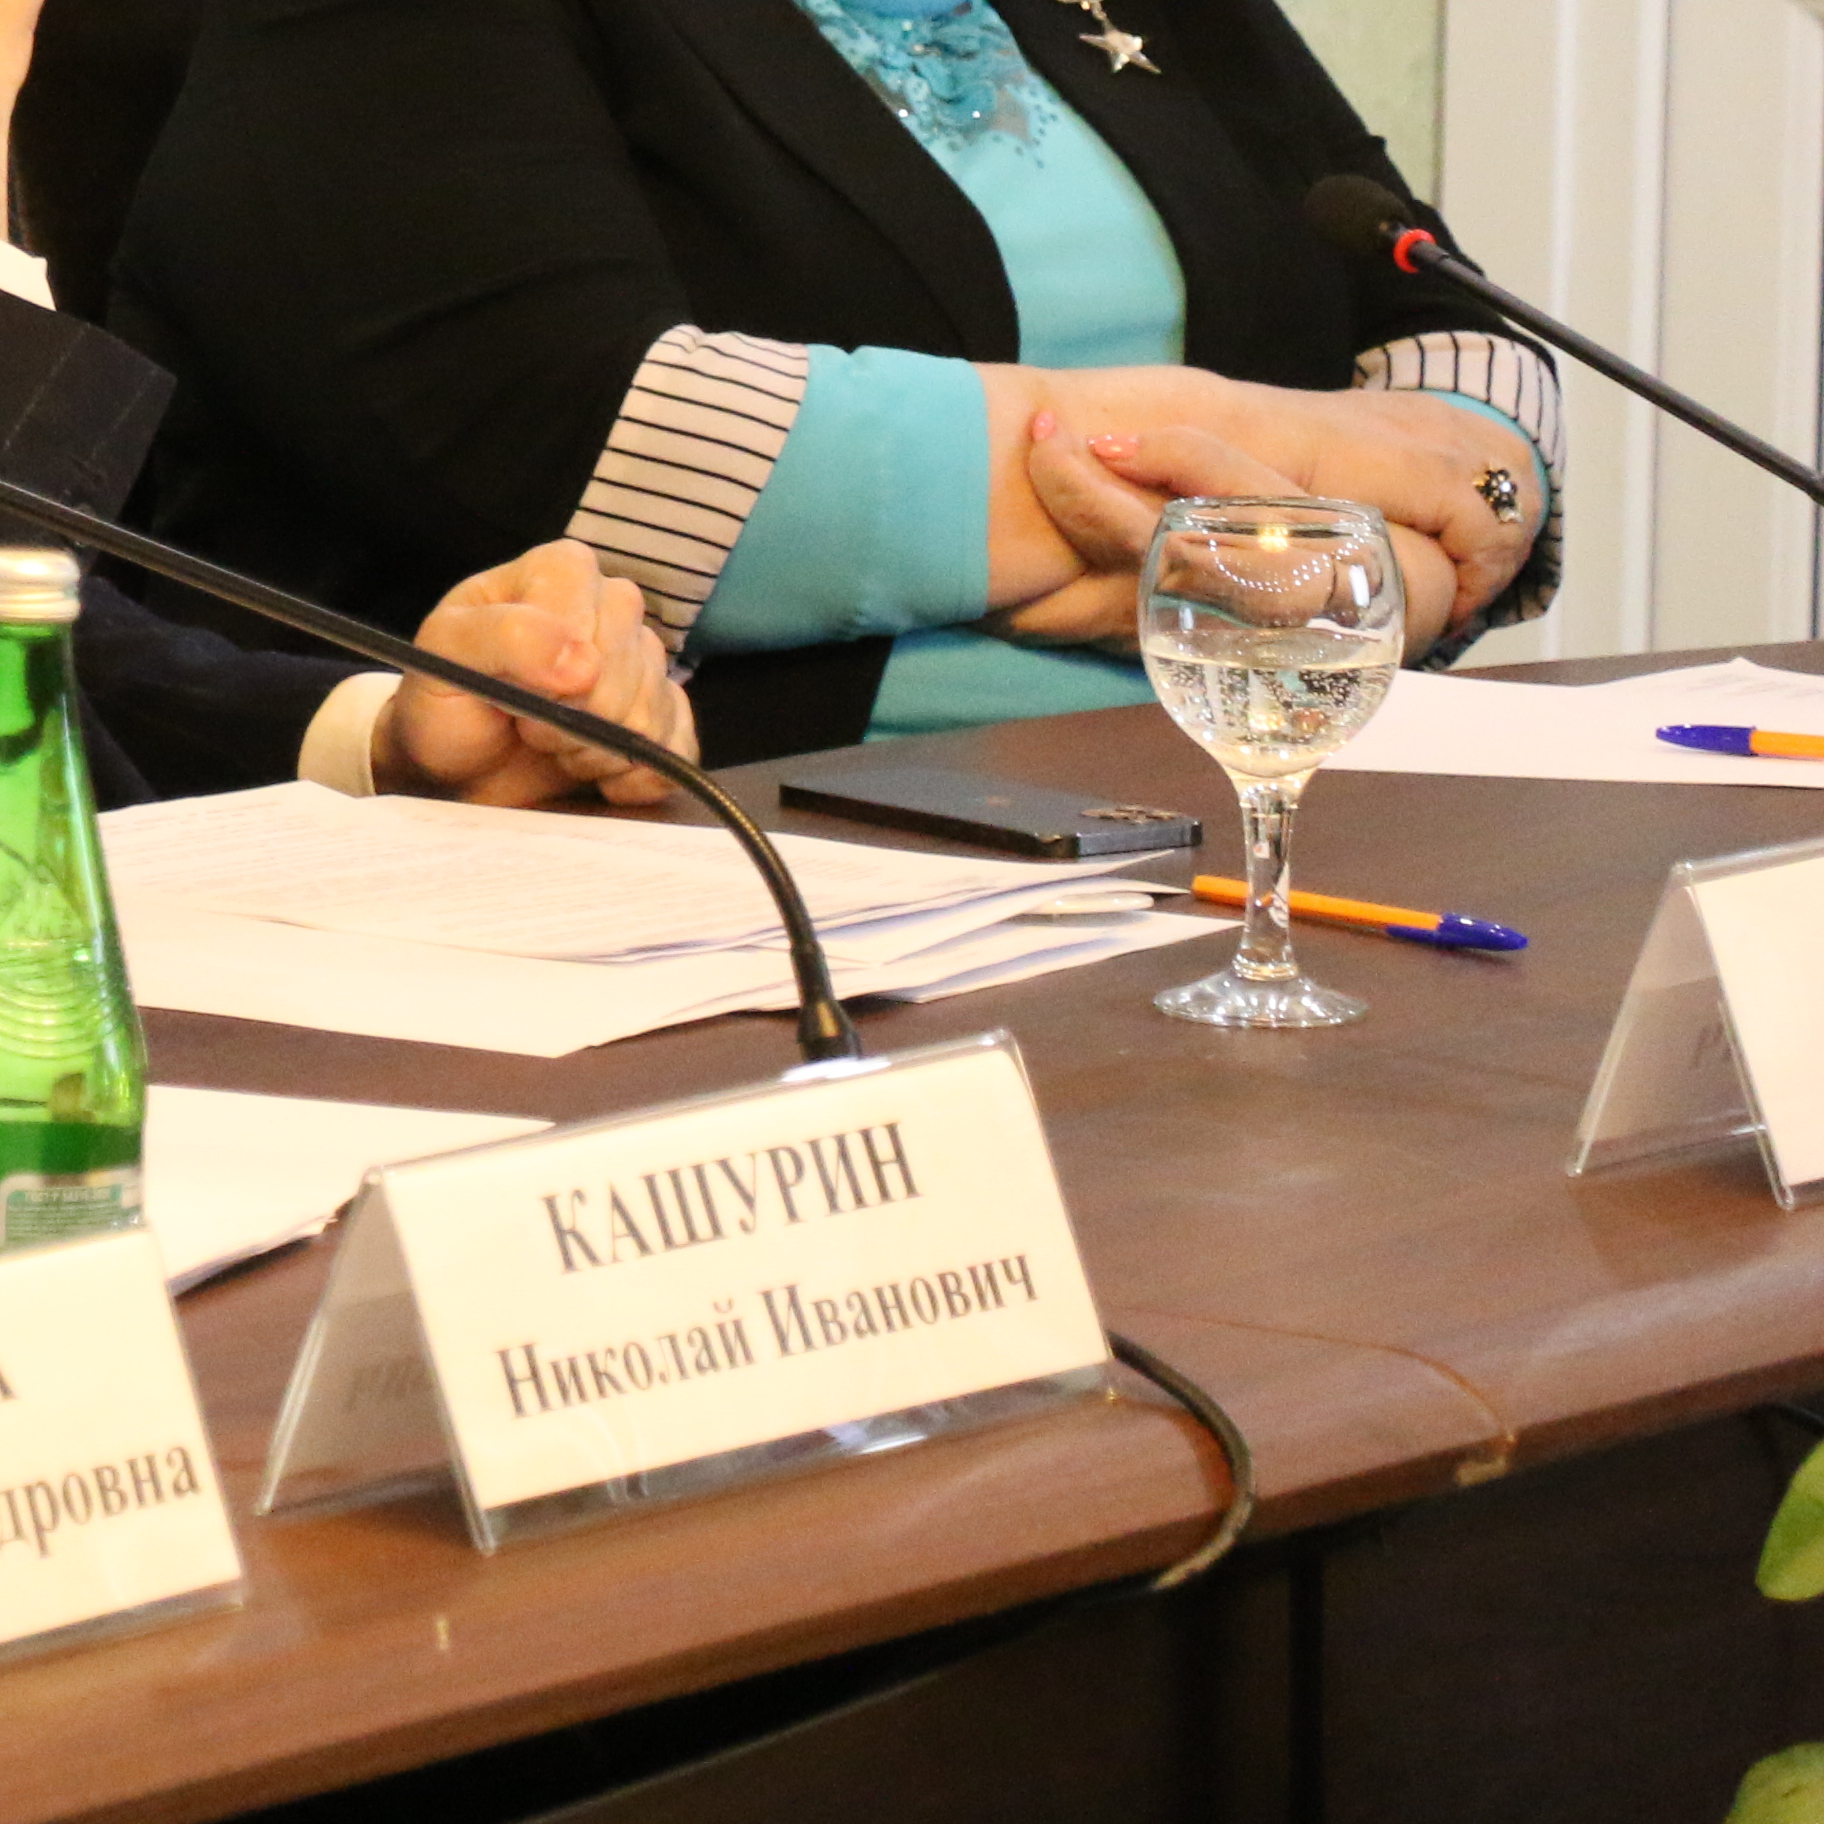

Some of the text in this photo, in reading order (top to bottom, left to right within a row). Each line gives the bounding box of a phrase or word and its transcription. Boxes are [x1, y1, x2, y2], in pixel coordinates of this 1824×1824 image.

[539, 1122, 925, 1276] КАШУРИН
[493, 1252, 1040, 1421] Николай Иванович
